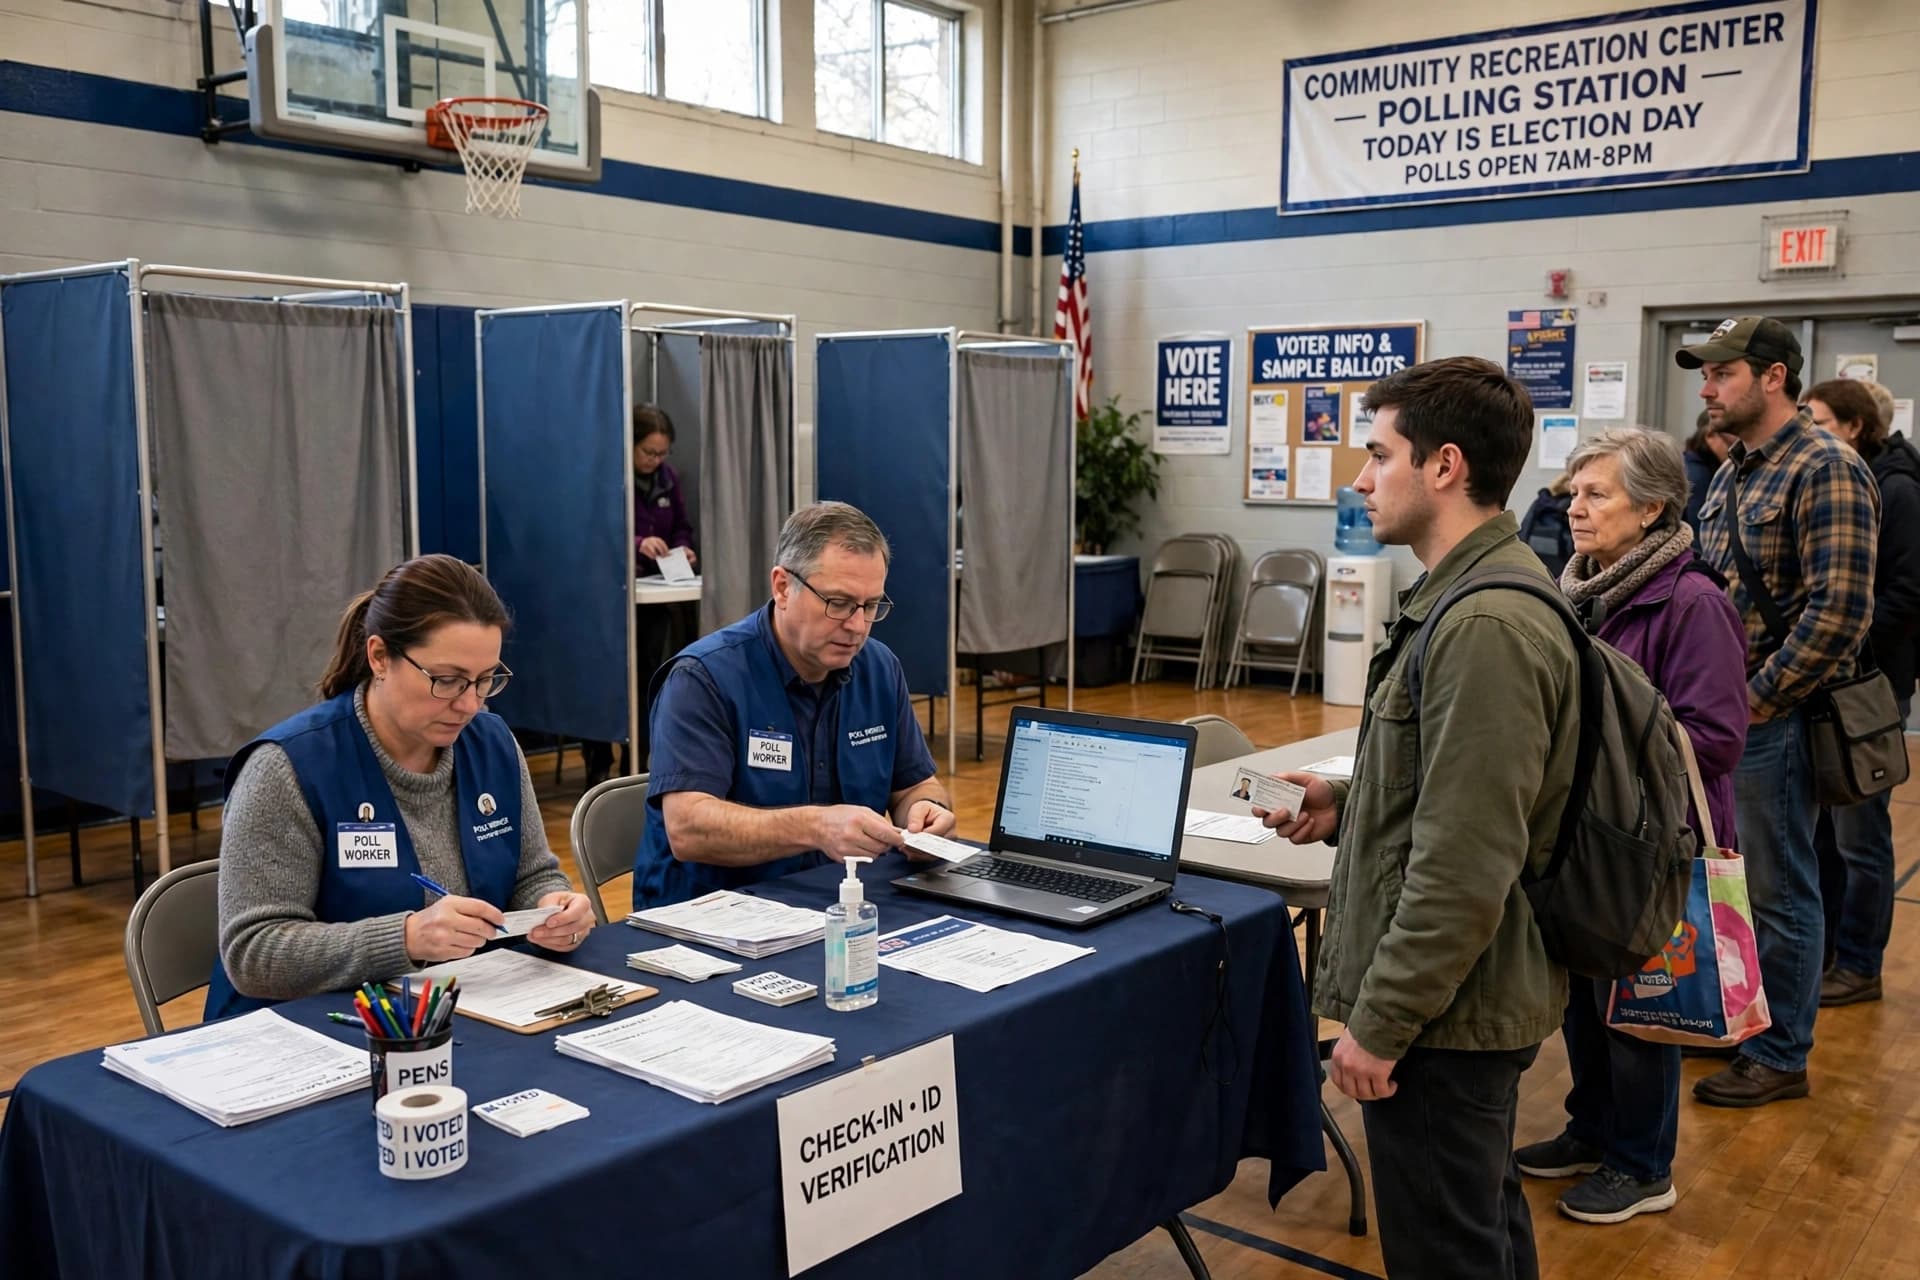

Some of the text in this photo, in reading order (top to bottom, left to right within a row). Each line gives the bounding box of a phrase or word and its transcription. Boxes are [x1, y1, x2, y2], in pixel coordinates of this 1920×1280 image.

[1304, 11, 1785, 101] COMMUNITY RECREATION CENTER
[1379, 63, 1687, 128] POLLING STATION
[1363, 101, 1704, 161] TODAY IS ELECTION DAY
[1405, 141, 1653, 185] POLLS OPEN 7AM-8PM
[1781, 229, 1827, 264] EXIT
[1276, 332, 1392, 356] VOTER INFO &
[1165, 346, 1222, 376] VOTE
[1262, 355, 1406, 379] SAMPLE BALLOTS
[1165, 377, 1221, 406] HERE
[752, 751, 787, 765] WORKER
[760, 741, 781, 753] POLL
[344, 848, 391, 861] WORKER
[354, 835, 381, 847] POLL
[759, 979, 792, 991] VOTED
[775, 983, 808, 995] VOTED
[398, 1059, 449, 1086] PENS
[403, 1125, 409, 1143] I
[413, 1113, 464, 1143] VOTED
[800, 1099, 903, 1163] CHECK-IN
[922, 1085, 941, 1113] ID
[404, 1151, 410, 1169] I
[414, 1138, 465, 1169] VOTED
[800, 1121, 945, 1205] VERIFICATION
